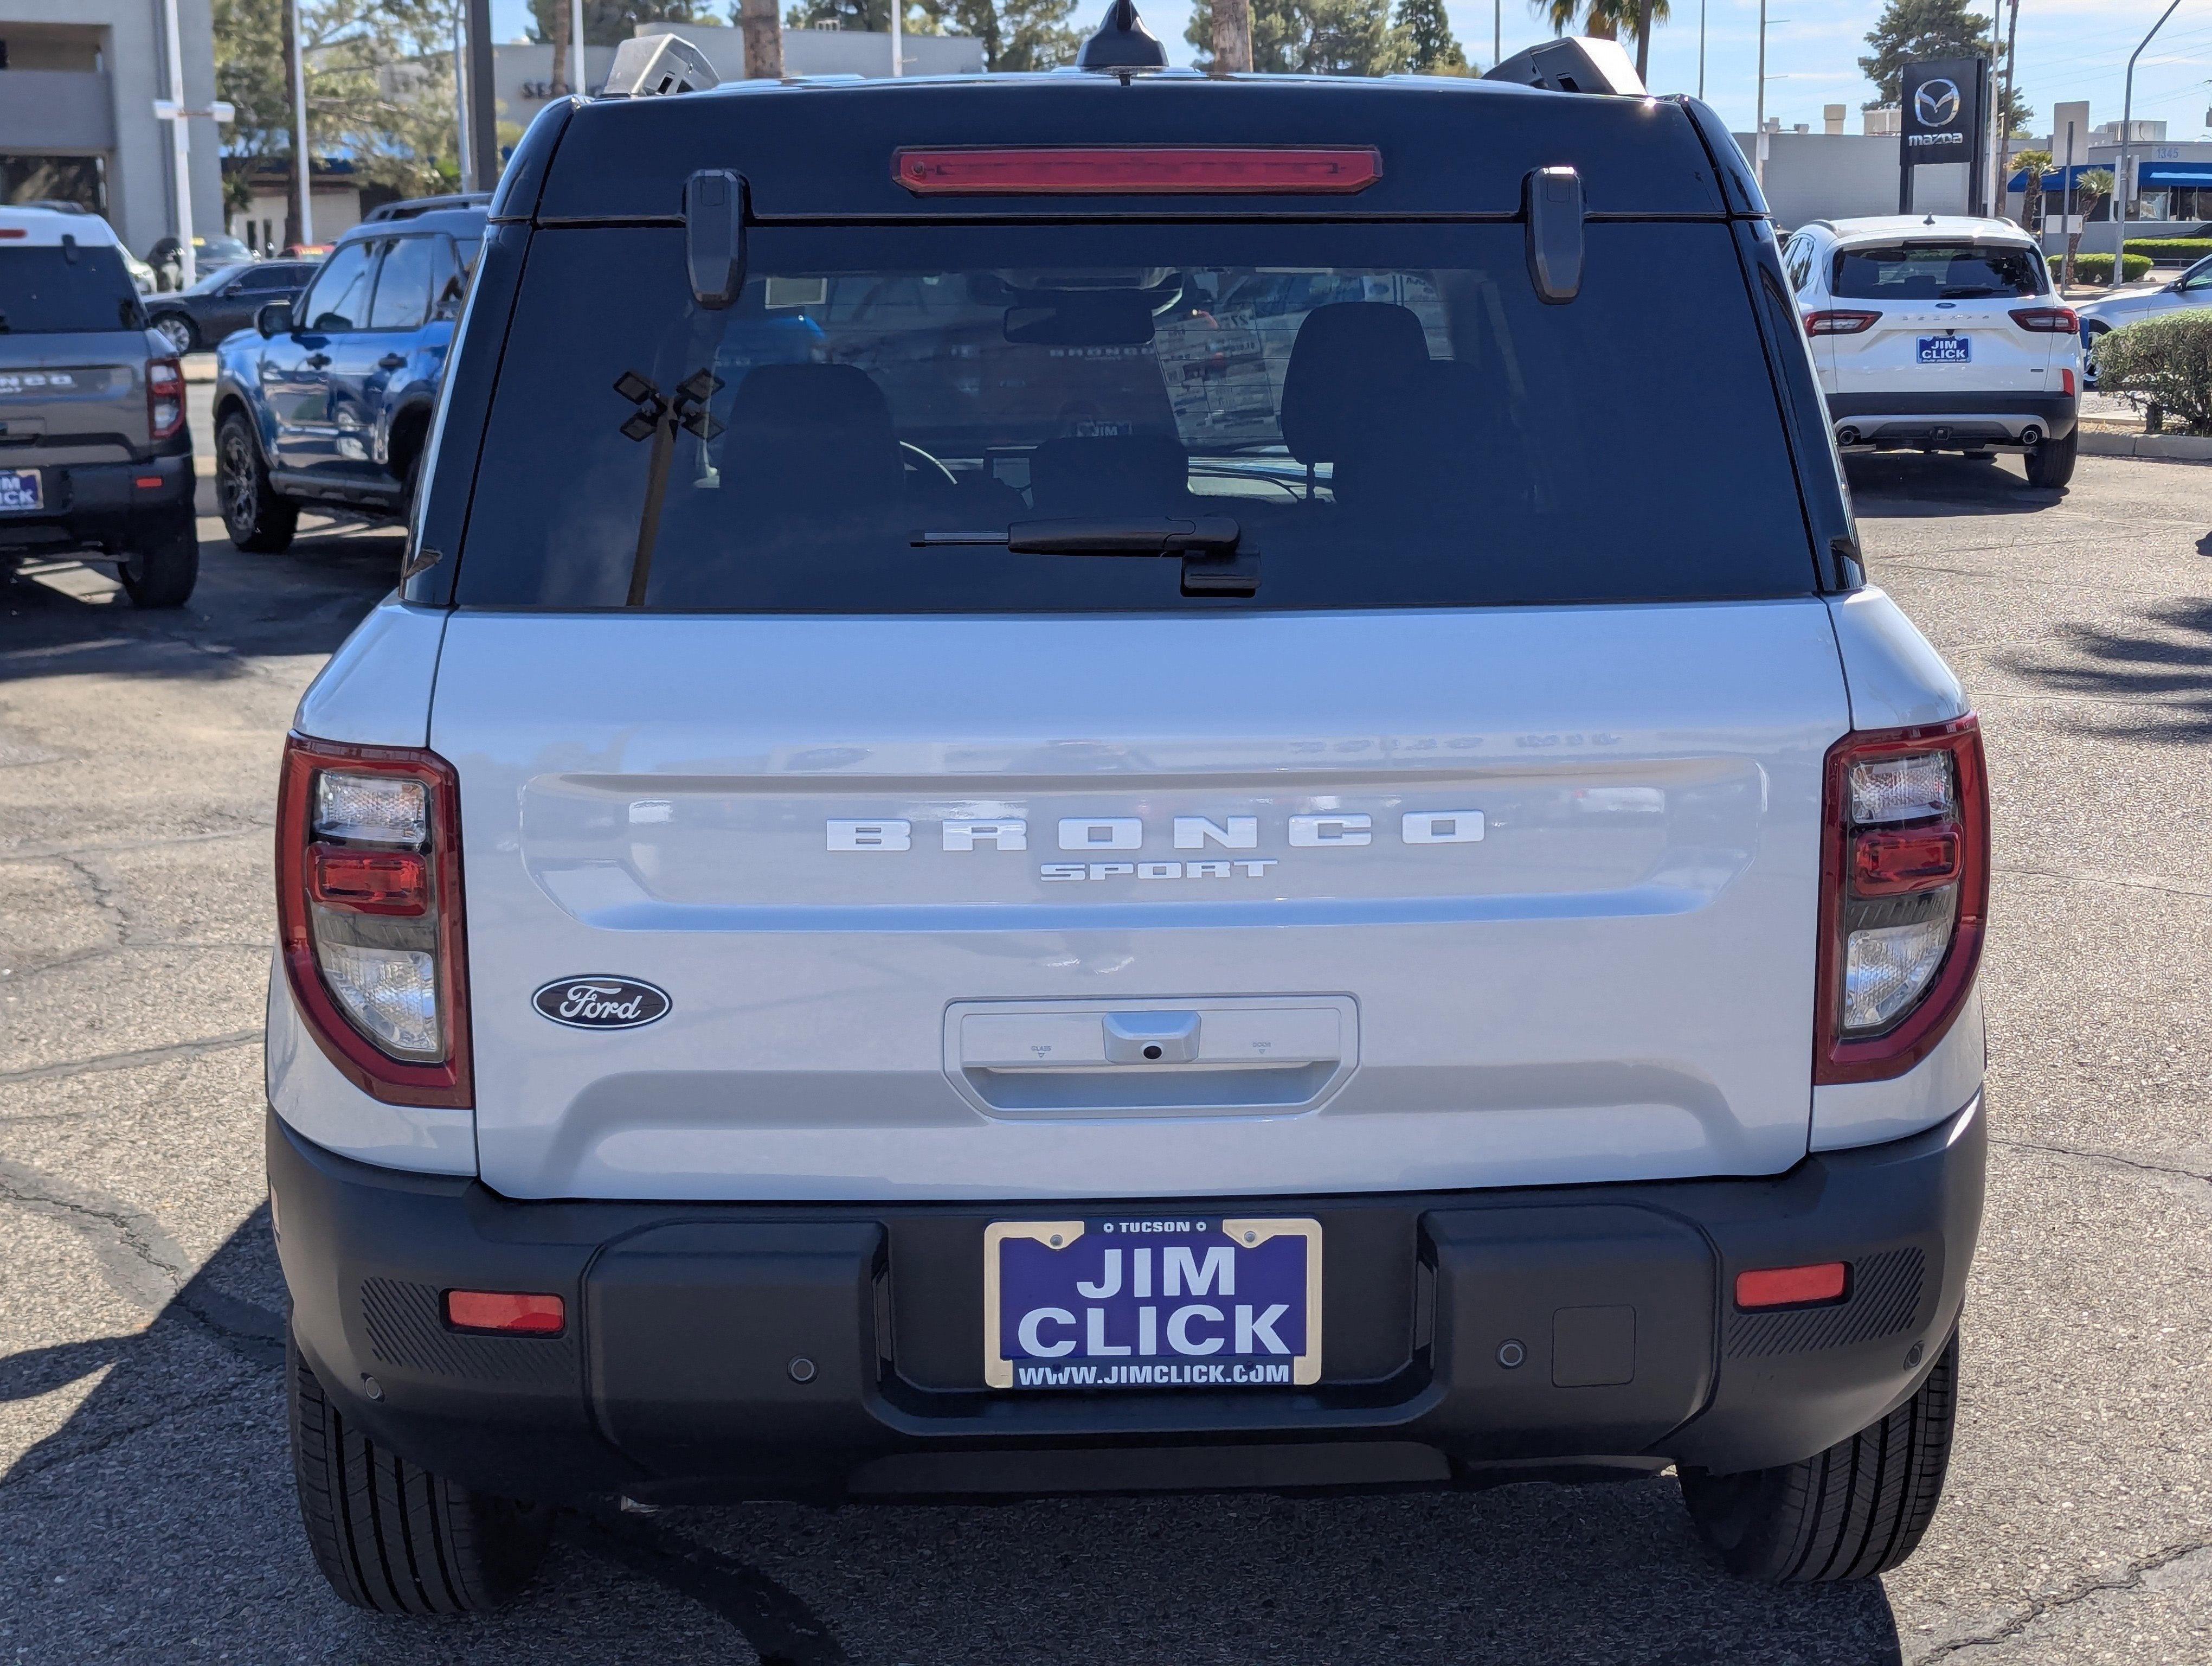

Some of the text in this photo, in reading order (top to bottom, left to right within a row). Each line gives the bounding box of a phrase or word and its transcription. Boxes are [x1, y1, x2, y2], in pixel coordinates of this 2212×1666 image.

[1922, 349, 1965, 359] CLICK
[1931, 341, 1957, 349] JIM
[826, 810, 1485, 851] BRONCO
[1040, 859, 1278, 881] SPORT
[559, 985, 643, 1019] Ford
[1119, 1221, 1191, 1233] TUCSON
[1076, 1247, 1235, 1298] JIM
[1018, 1304, 1291, 1357] CLICK
[1018, 1364, 1289, 1385] WWW.JIMCLICK.COM
